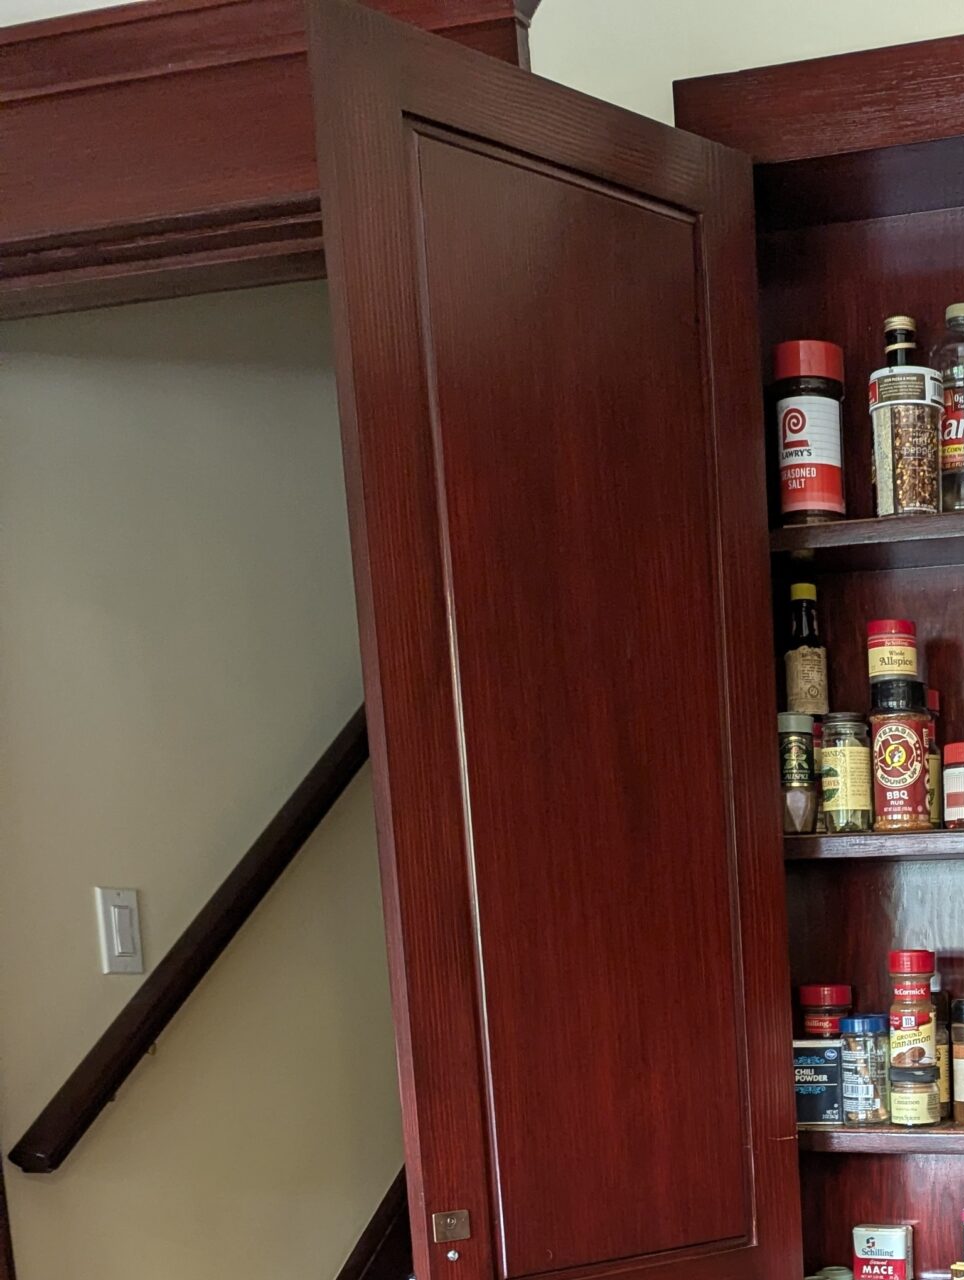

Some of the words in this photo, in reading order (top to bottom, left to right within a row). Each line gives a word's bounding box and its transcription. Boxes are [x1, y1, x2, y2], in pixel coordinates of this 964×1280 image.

[781, 448, 812, 460] LAWRY'S
[788, 478, 806, 491] SALT
[880, 657, 914, 668] Allspice
[886, 790, 909, 800] BBQ
[897, 1032, 923, 1042] GROUND
[891, 1035, 931, 1050] Cinnamon
[794, 1068, 815, 1076] CHILI
[794, 1074, 828, 1082] POWDER
[861, 1247, 895, 1257] Schilling
[862, 1265, 894, 1275] MACE
